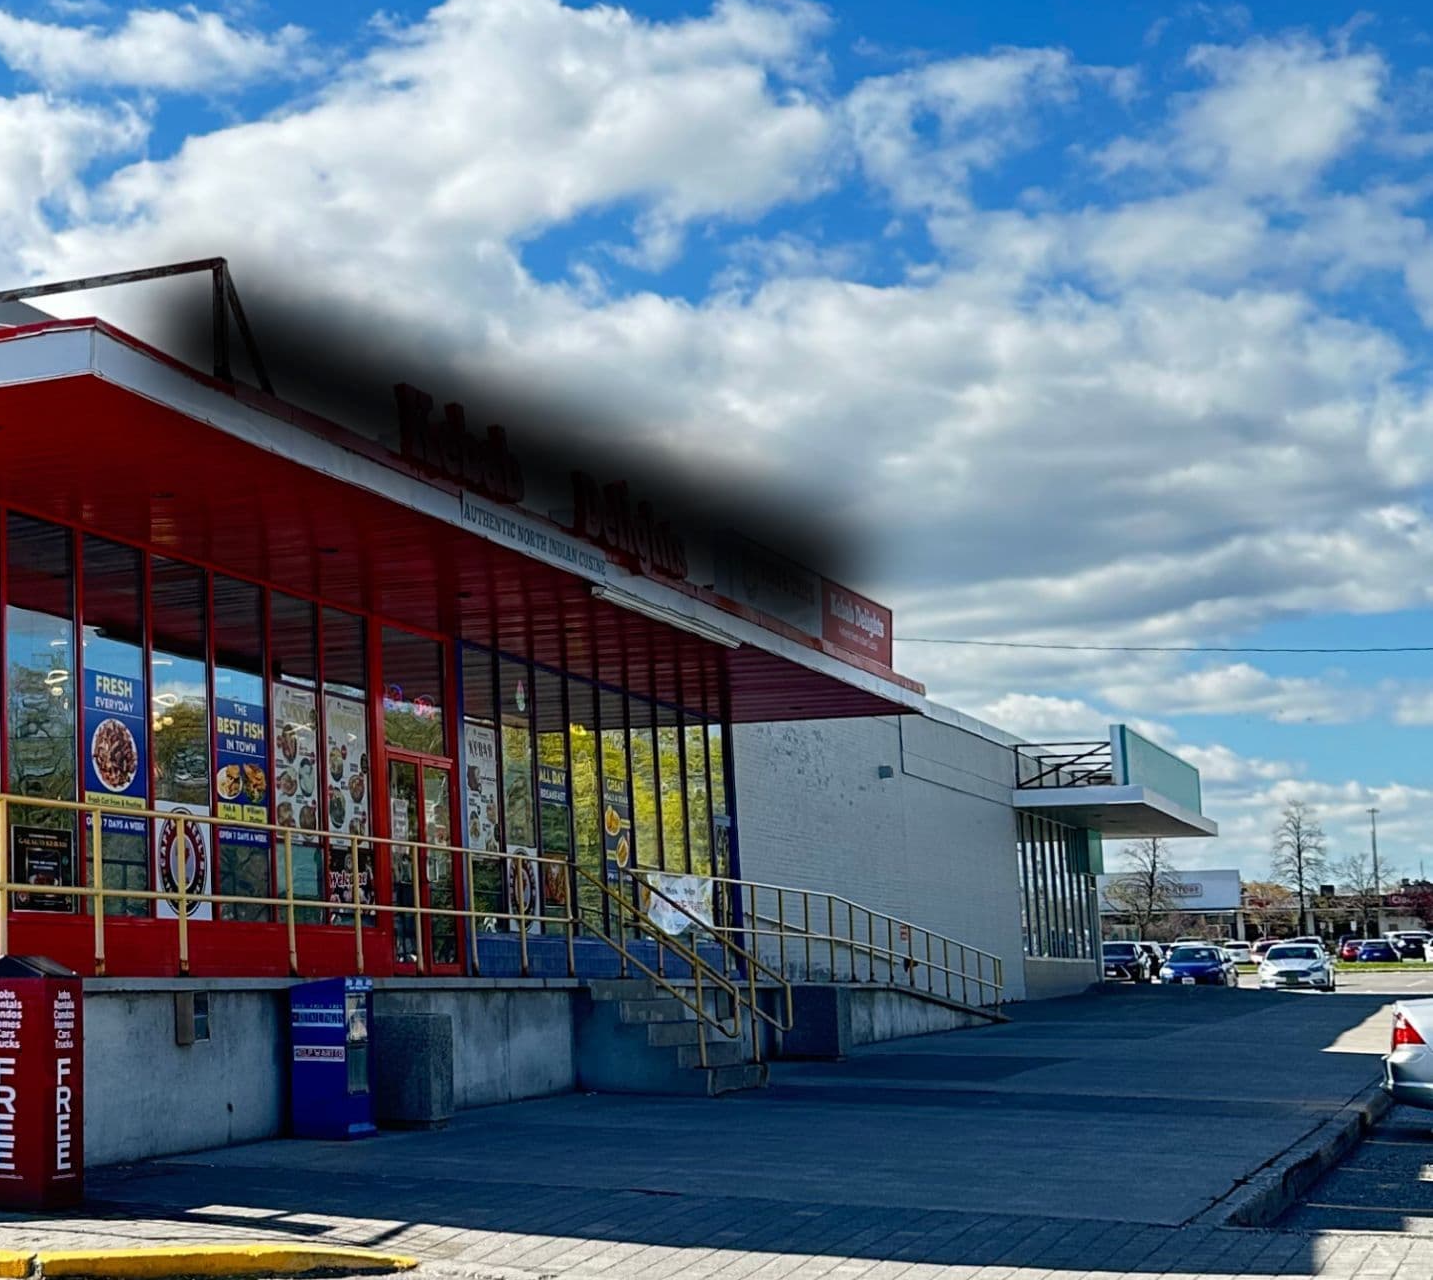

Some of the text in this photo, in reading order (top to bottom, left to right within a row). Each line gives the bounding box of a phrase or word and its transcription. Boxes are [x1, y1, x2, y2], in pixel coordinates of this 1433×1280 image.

[464, 503, 516, 539] AUTHENTIC
[517, 524, 546, 553] NORTH
[548, 538, 578, 564] INDIAN
[95, 674, 133, 698] FRESH
[95, 697, 134, 713] EVERYDAY
[234, 703, 248, 716] THE
[217, 716, 264, 740] BEST FISH
[226, 739, 257, 754] IN TOWN
[539, 767, 566, 786] ALL DAY
[103, 818, 108, 827] 7
[108, 818, 123, 830] DAYS
[124, 821, 129, 830] A
[130, 821, 146, 832] WEEK
[328, 870, 368, 888] Welcme
[58, 990, 71, 1000] Jobs
[54, 999, 75, 1010] Rentals
[54, 1010, 75, 1020] Condos
[54, 1020, 74, 1030] Homes
[57, 1030, 71, 1039] Cars
[55, 1039, 74, 1049] Trucks
[56, 1058, 72, 1170] FREE
